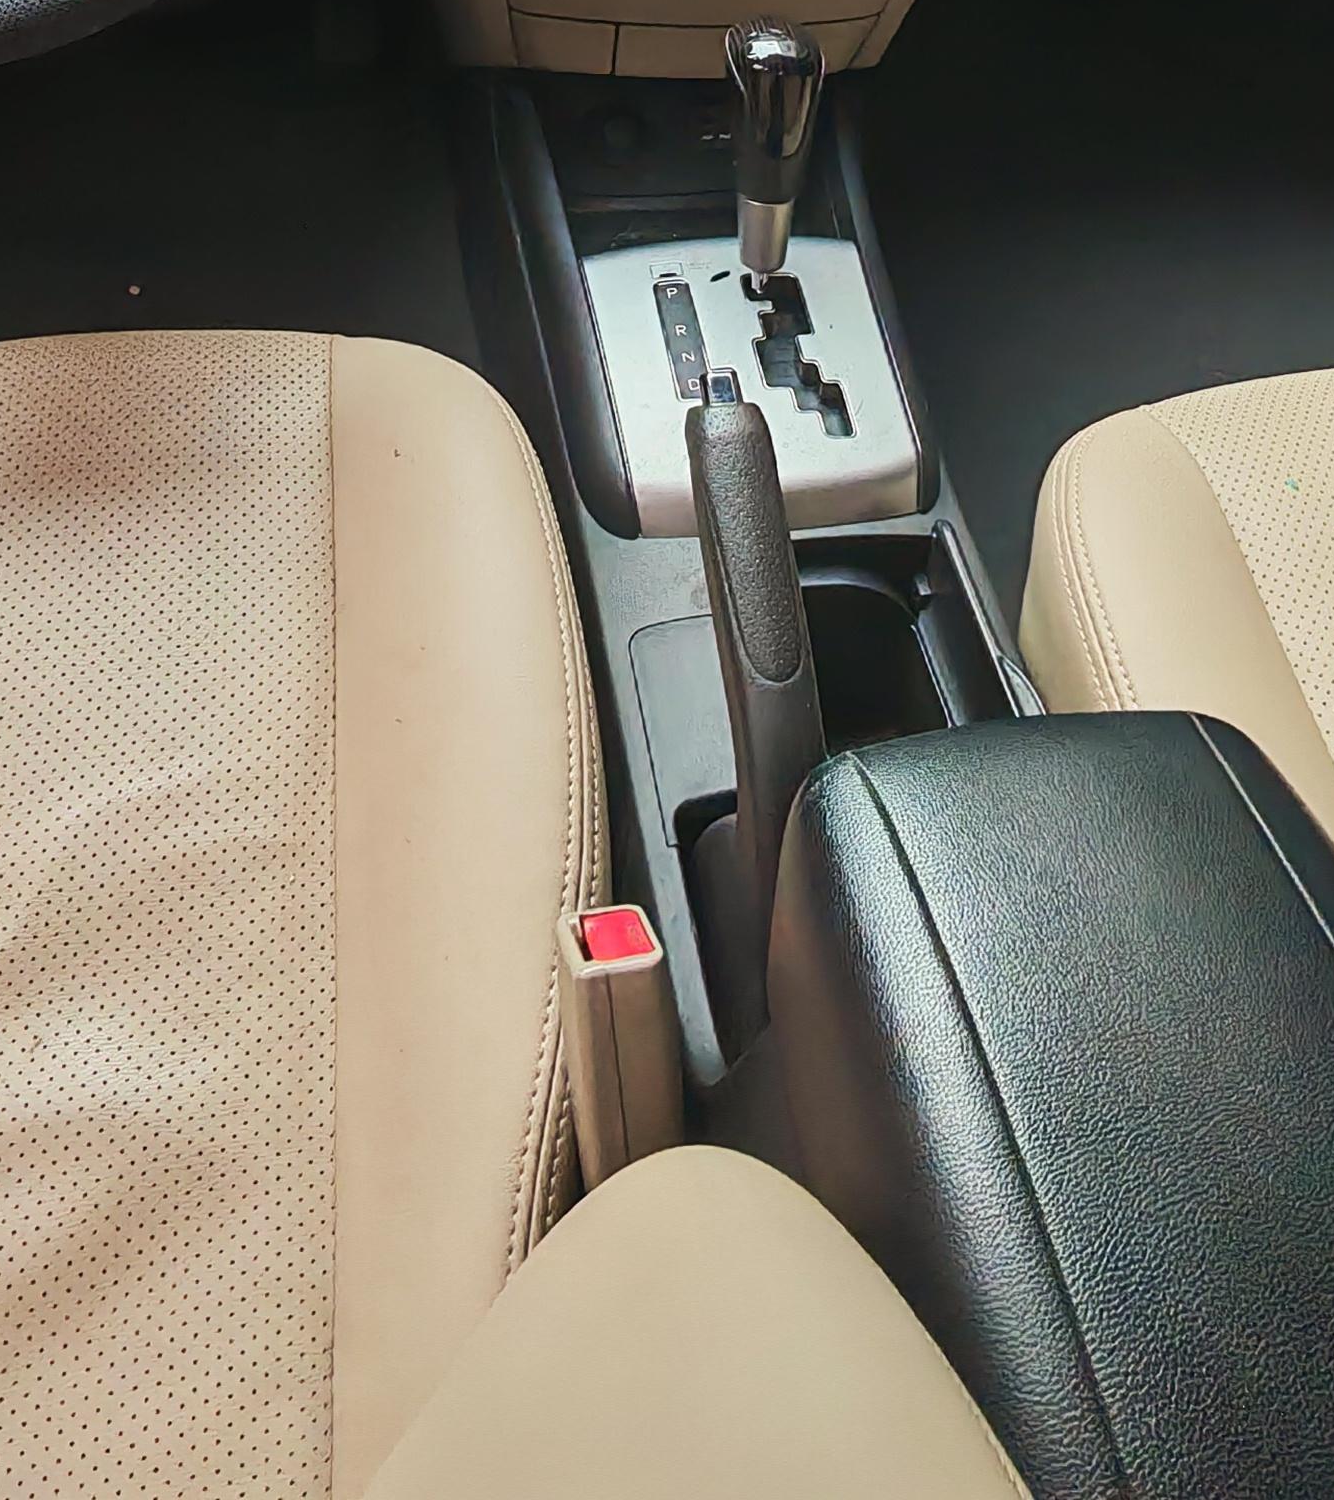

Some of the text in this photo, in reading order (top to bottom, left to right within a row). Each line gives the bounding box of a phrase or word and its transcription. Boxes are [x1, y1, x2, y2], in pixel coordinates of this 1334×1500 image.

[666, 287, 678, 299] P
[675, 324, 687, 337] R
[682, 352, 695, 363] N
[688, 378, 700, 391] D
